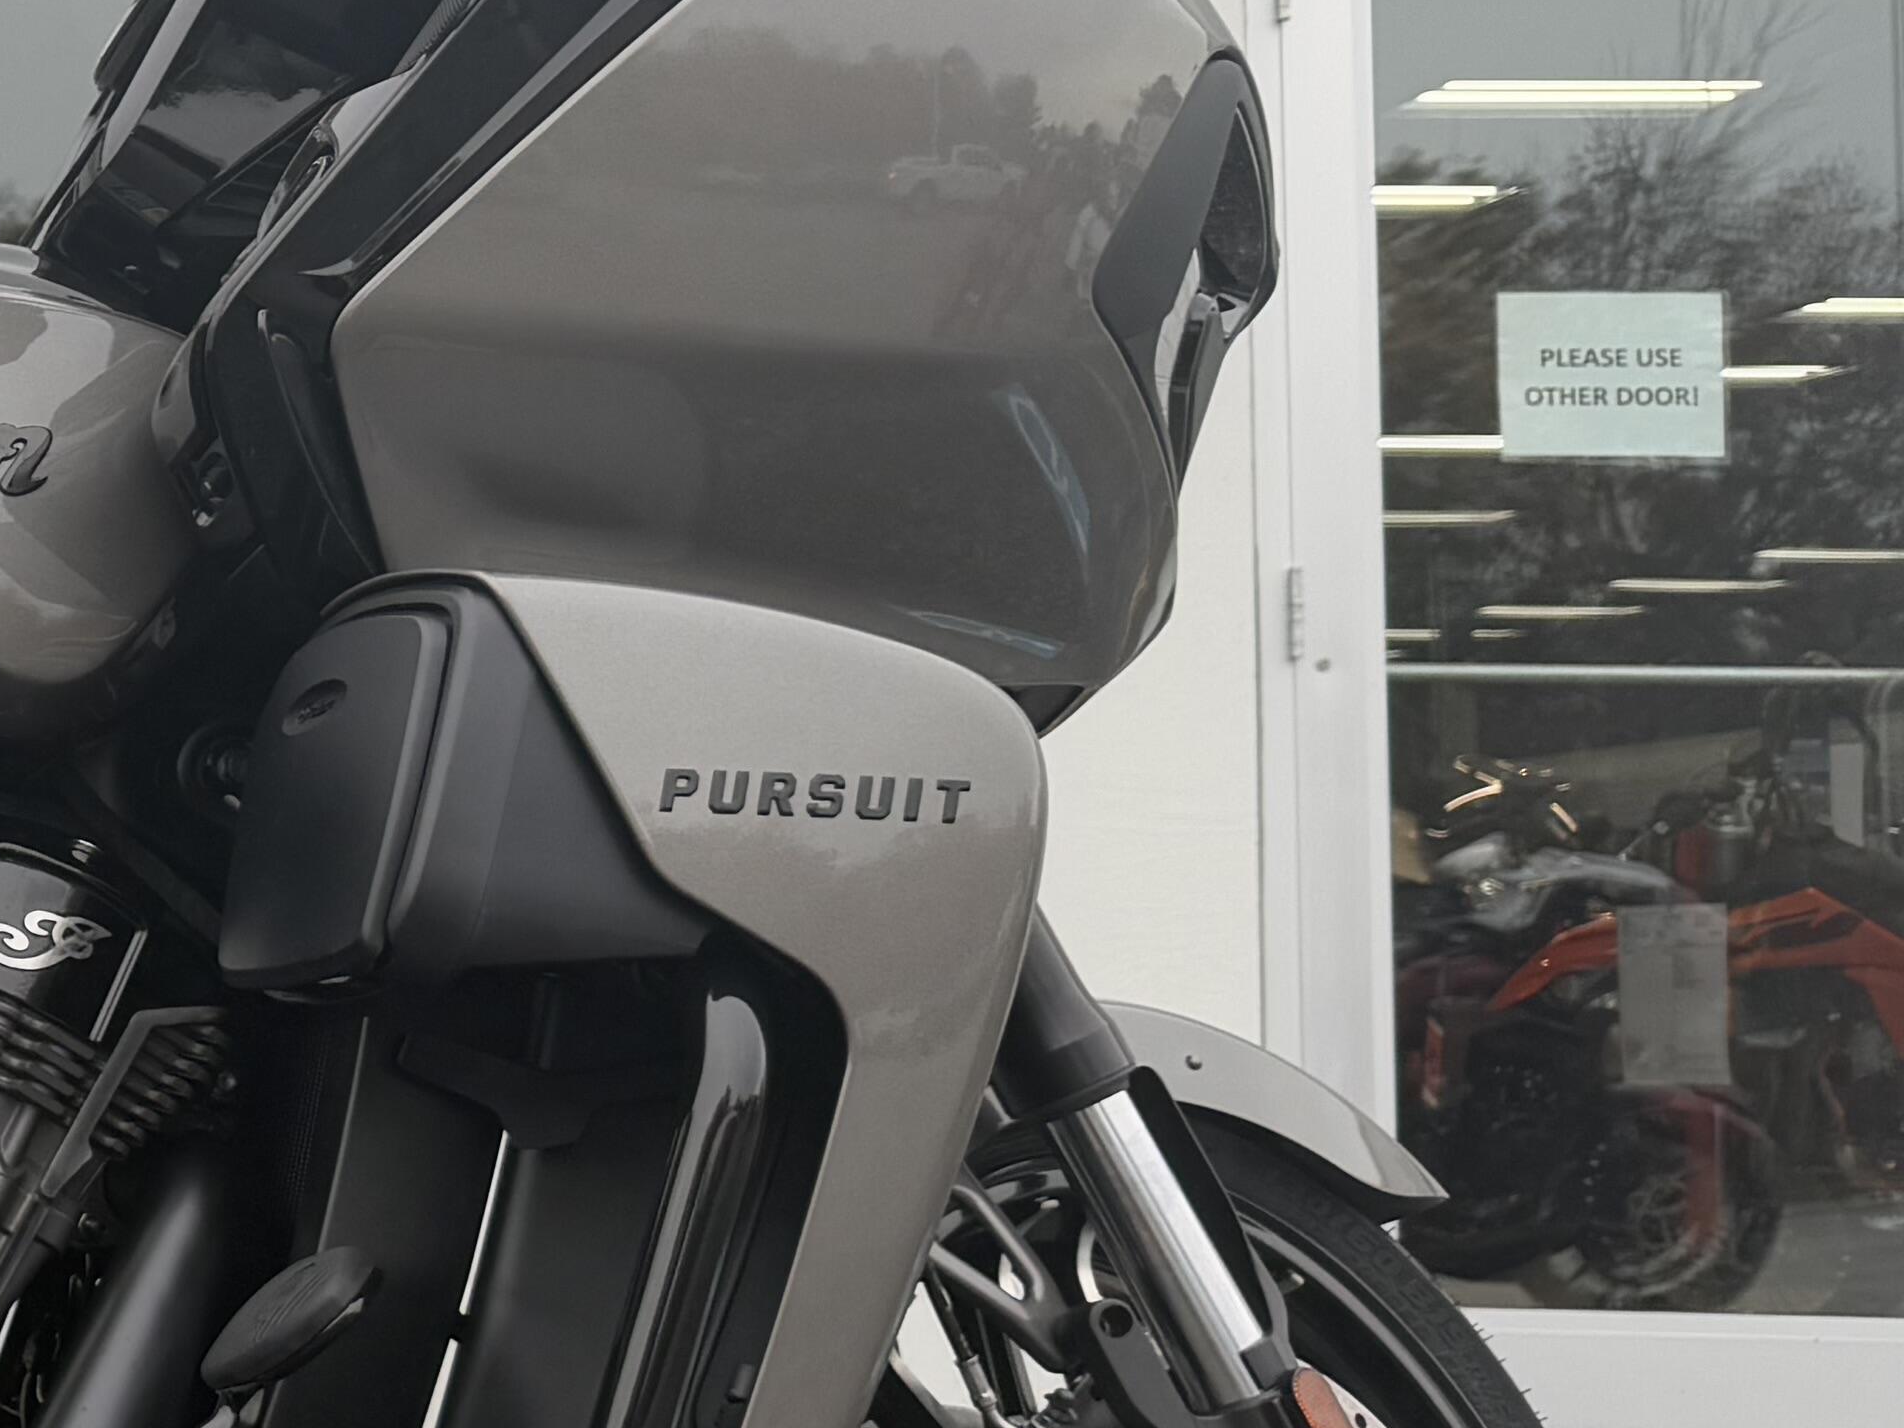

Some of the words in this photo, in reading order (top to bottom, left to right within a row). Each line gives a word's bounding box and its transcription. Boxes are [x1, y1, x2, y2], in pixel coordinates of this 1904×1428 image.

[1540, 347, 1628, 368] PLEASE
[1636, 347, 1683, 368] USE
[1524, 386, 1609, 407] OTHER
[1616, 386, 1700, 407] DOOR!
[658, 768, 972, 824] PURSUIT
